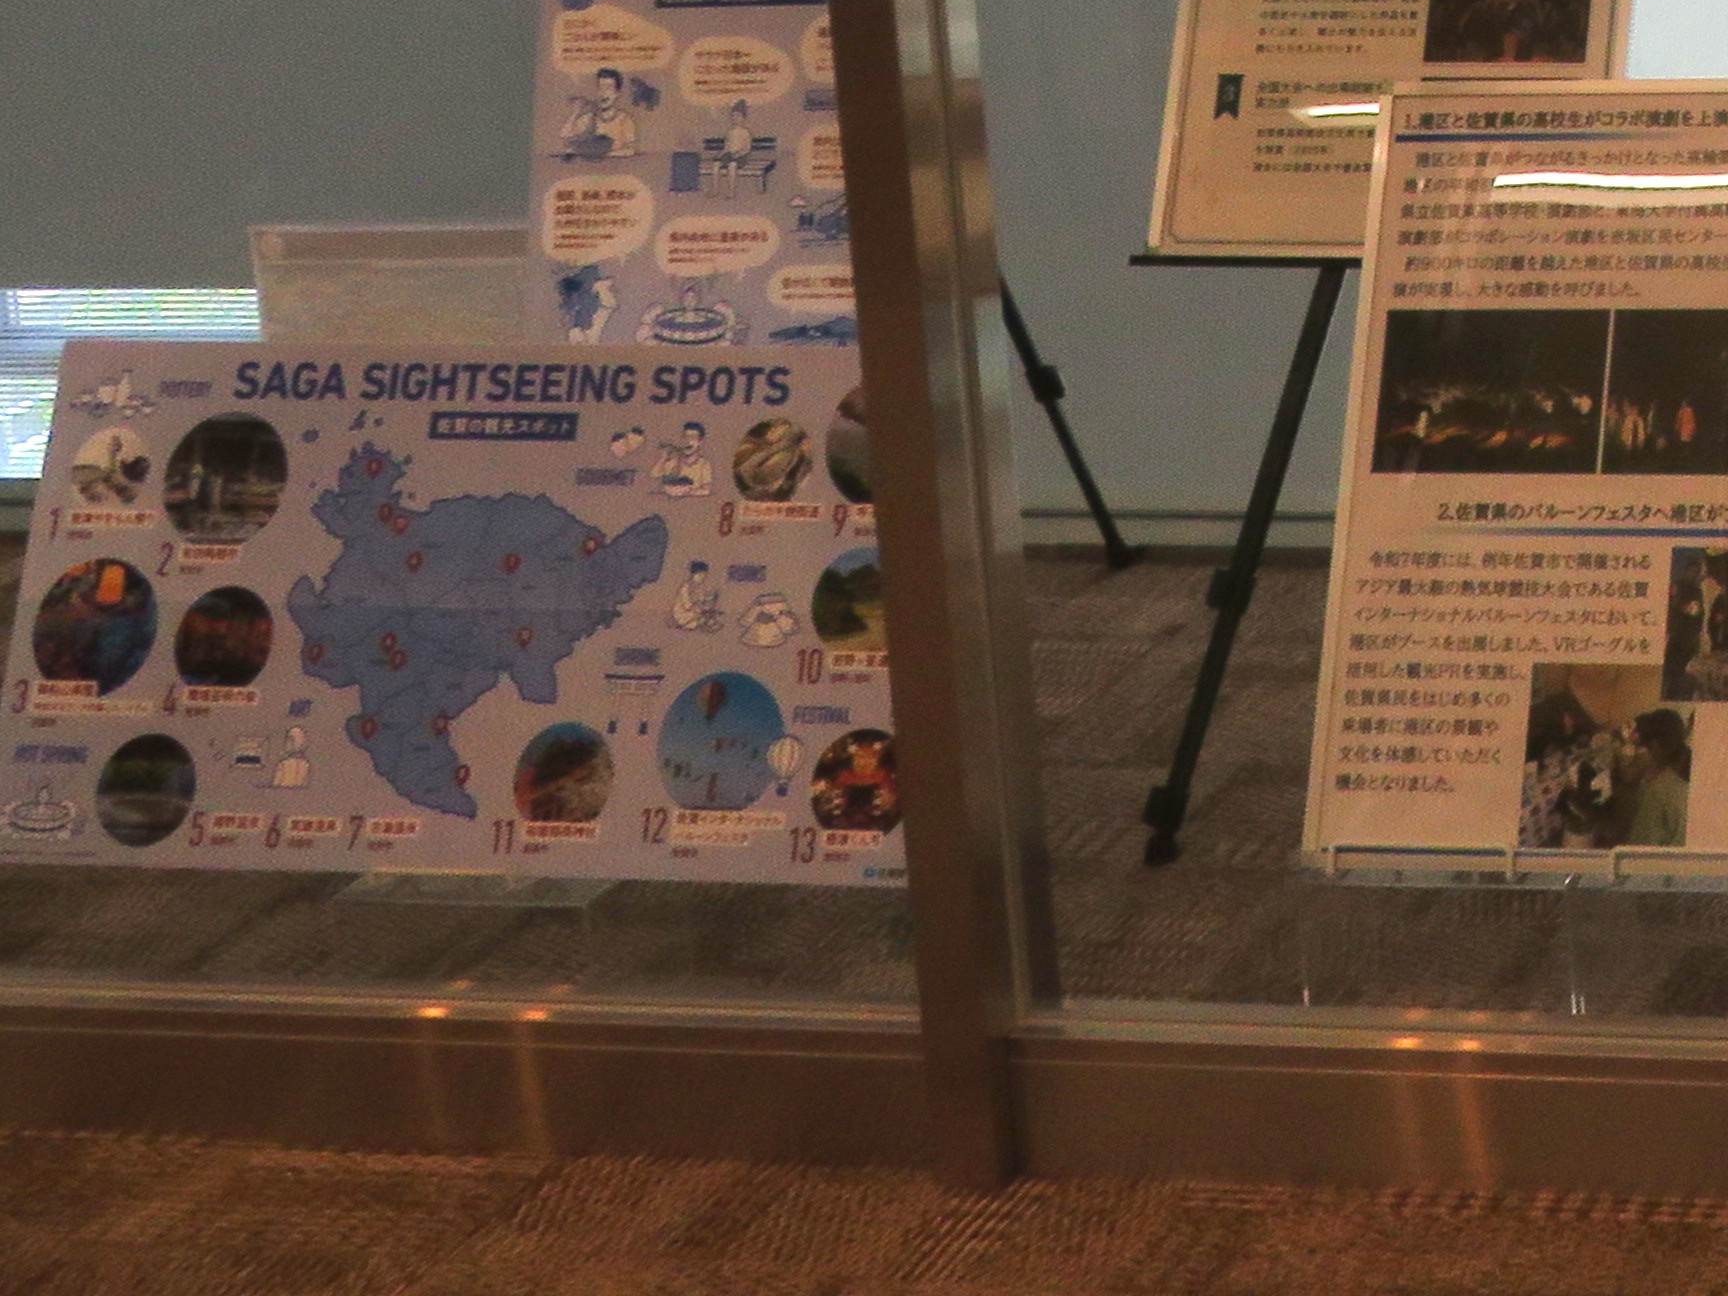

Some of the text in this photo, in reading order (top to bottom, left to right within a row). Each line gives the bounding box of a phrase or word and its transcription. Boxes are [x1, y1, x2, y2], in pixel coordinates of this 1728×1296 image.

[234, 361, 790, 406] SAGA SIGHTSEEING SPOTS
[720, 503, 733, 536] 8
[156, 543, 174, 576] 2
[797, 649, 822, 684] 10
[189, 815, 204, 846] 5
[265, 817, 280, 847] 6
[348, 817, 363, 850] 7
[493, 820, 515, 853] 11
[641, 808, 668, 844] 12
[790, 826, 815, 864] 13
